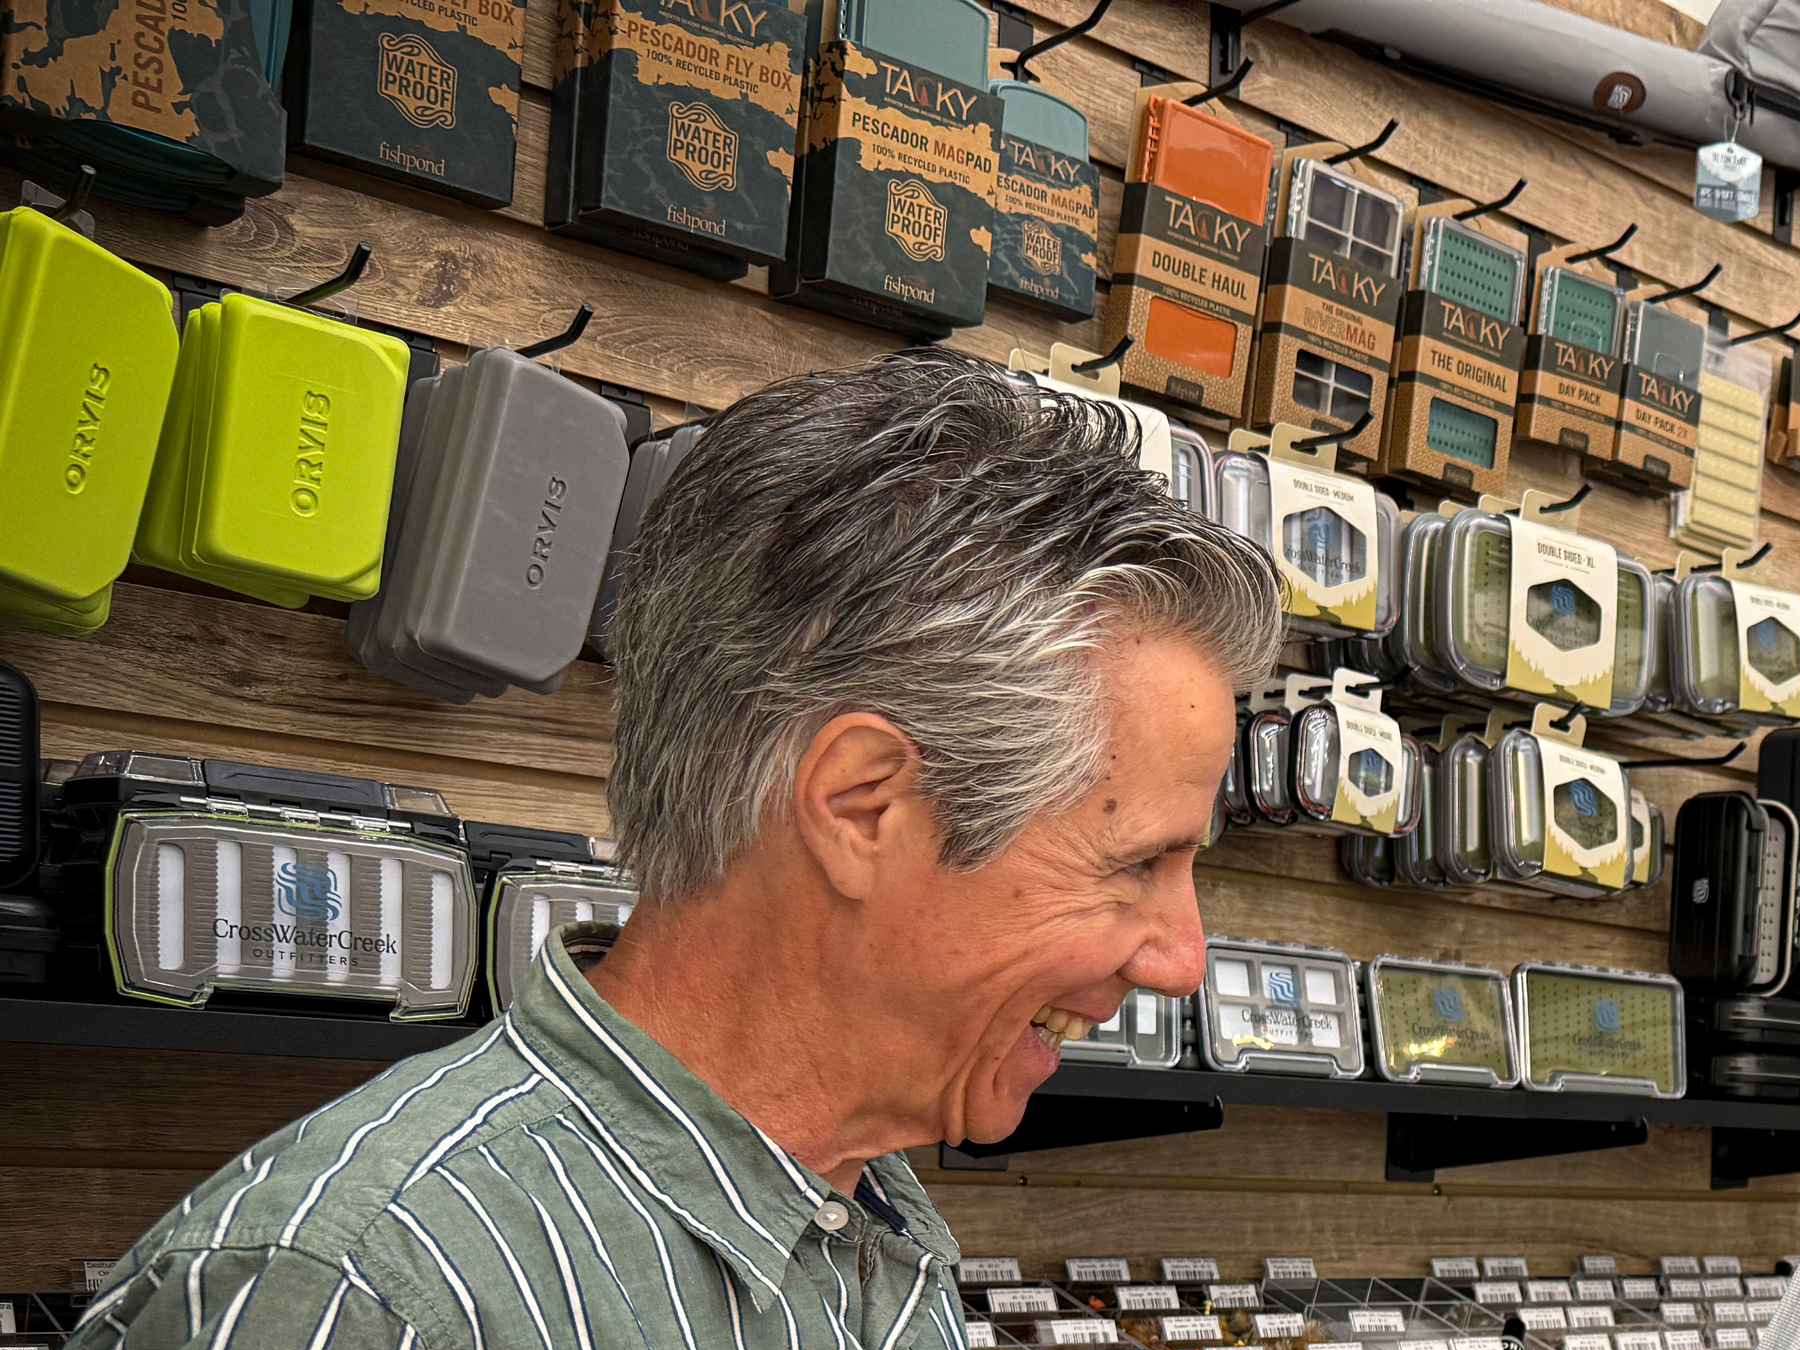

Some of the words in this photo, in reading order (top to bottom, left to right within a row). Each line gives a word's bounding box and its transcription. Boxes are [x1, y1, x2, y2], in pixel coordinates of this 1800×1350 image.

[438, 7, 478, 26] PLASTIC
[384, 51, 452, 91] WATER
[626, 19, 720, 68] PESCADOR
[725, 53, 754, 79] FLY
[759, 64, 793, 93] BOX
[646, 48, 673, 66] 100%
[675, 59, 721, 82] RECYCLED
[722, 74, 760, 95] PLASTIC
[383, 73, 451, 109] PROOF
[674, 118, 734, 154] WATER
[851, 110, 929, 153] PESCADOR
[932, 140, 993, 174] MAGPAD
[379, 140, 446, 177] fishpond
[672, 138, 734, 172] PROOF
[871, 143, 896, 161] 100%
[897, 152, 938, 174] RECYCLED
[938, 165, 971, 185] PLASTIC
[891, 197, 943, 227] WATER
[996, 174, 1048, 204] ESCADOR
[1050, 192, 1096, 220] MAGPAD
[667, 204, 727, 237] fishpond
[890, 214, 943, 245] PROOF
[1025, 243, 1060, 265] PROOF
[1026, 231, 1060, 252] WATER
[882, 273, 936, 305] fishpond
[1151, 249, 1207, 286] DOUBLE
[1211, 270, 1248, 301] HAUL
[1430, 349, 1454, 372] THE
[1456, 358, 1508, 394] ORIGINAL
[1557, 382, 1577, 398] DAY
[1578, 387, 1601, 406] PACK
[64, 362, 112, 496] ORVIS
[1635, 407, 1653, 422] DAY
[1654, 415, 1674, 433] PACK
[289, 389, 332, 518] ORVIS
[525, 474, 569, 591] ORVIS
[1536, 541, 1562, 559] DOUBLE
[212, 917, 398, 956] CrossWaterCreek
[252, 948, 359, 967] OUTFITTERS
[1241, 1007, 1333, 1032] CrossWaterCreek
